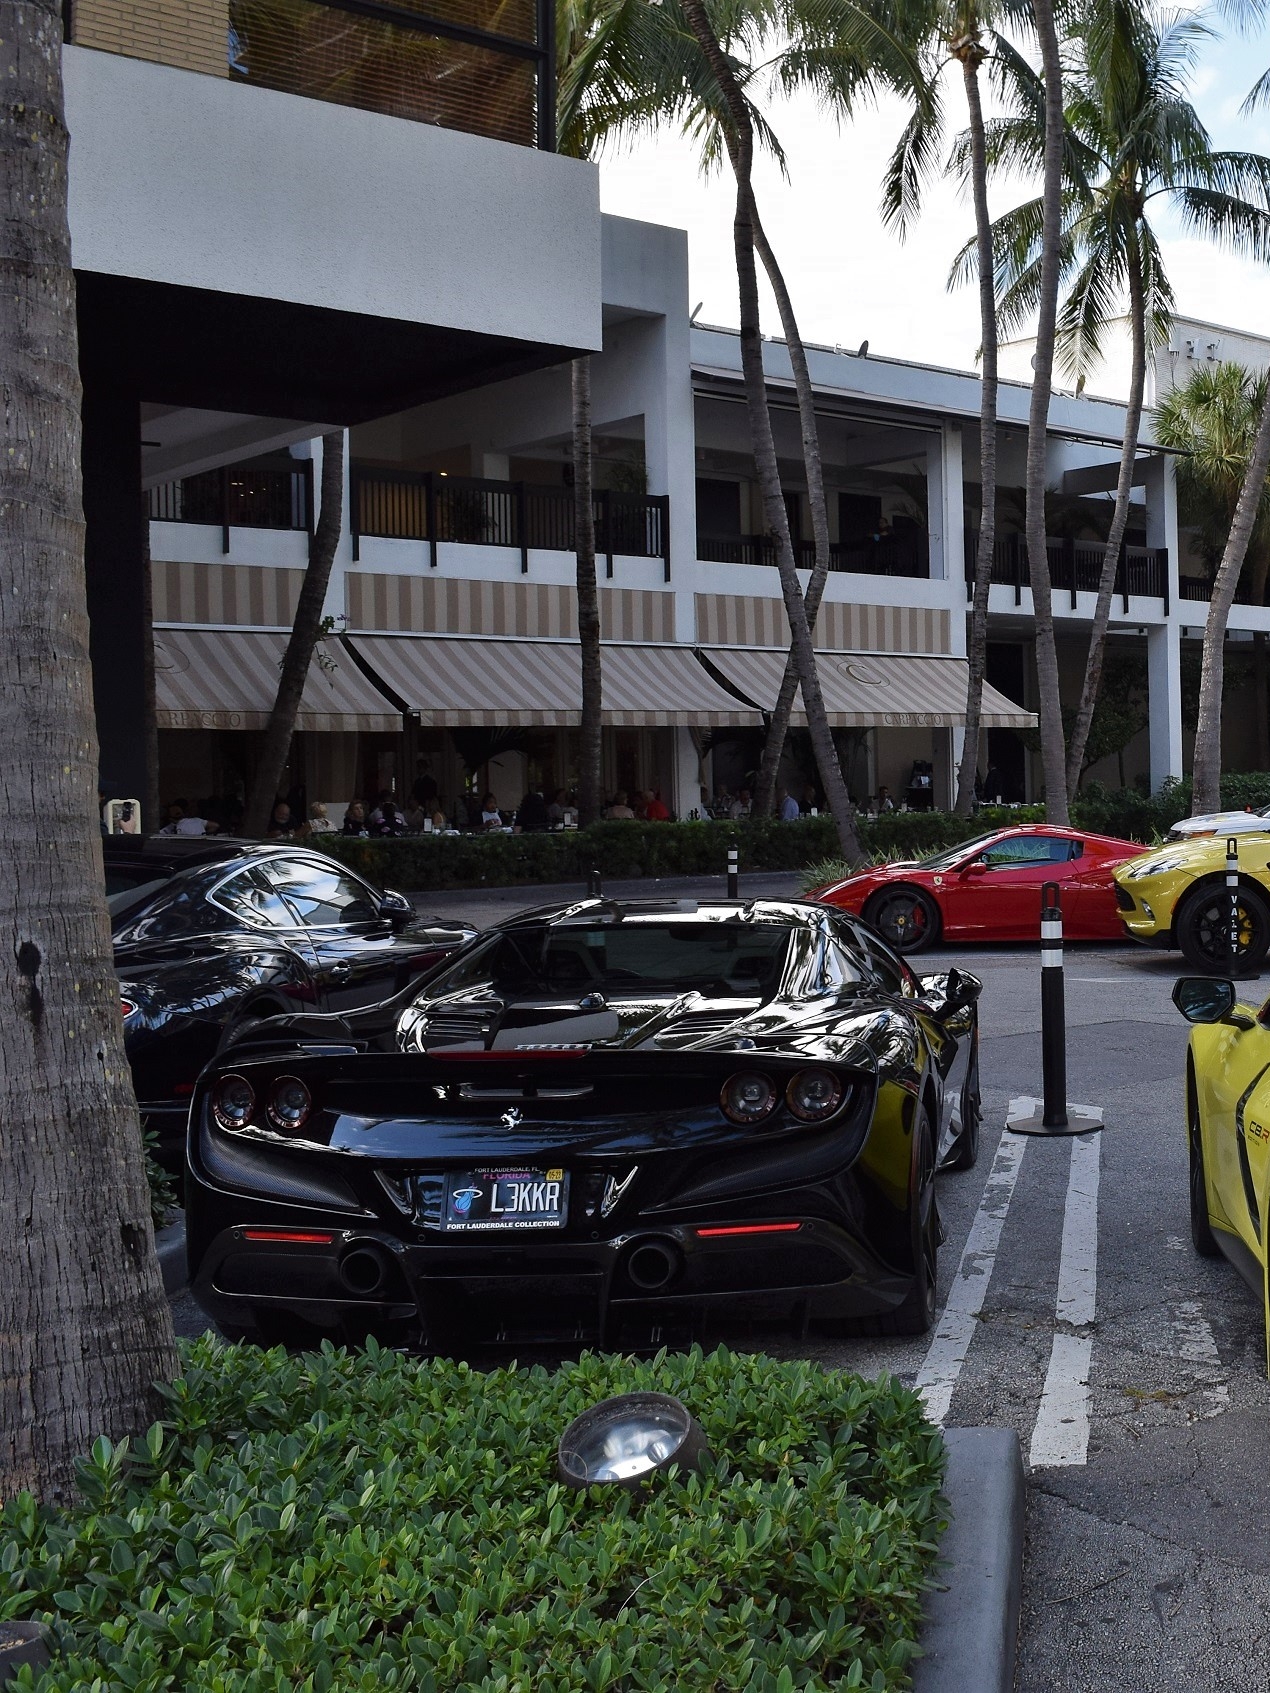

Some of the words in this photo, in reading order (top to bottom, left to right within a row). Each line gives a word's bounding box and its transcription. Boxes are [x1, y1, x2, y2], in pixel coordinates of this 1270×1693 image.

[157, 711, 241, 727] ARPACCIO
[884, 713, 942, 726] CARPACCIO
[491, 1182, 560, 1213] L3KKR
[514, 1220, 560, 1228] COLLECTION
